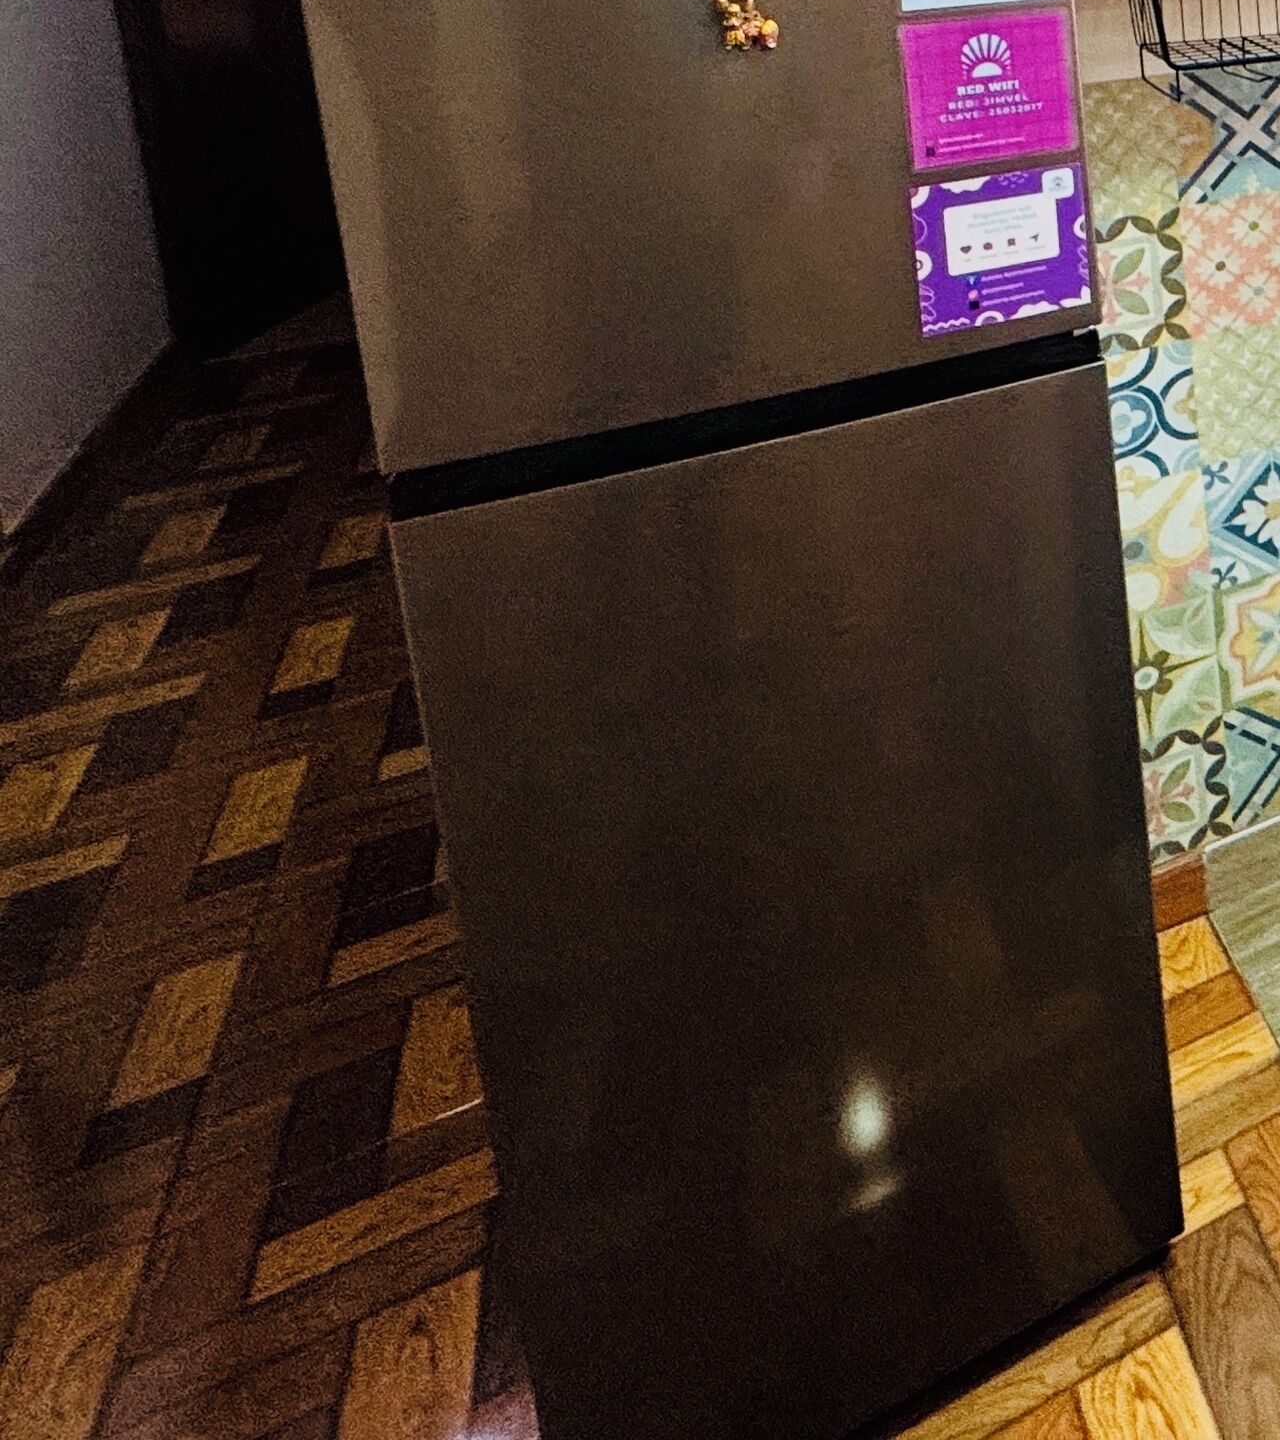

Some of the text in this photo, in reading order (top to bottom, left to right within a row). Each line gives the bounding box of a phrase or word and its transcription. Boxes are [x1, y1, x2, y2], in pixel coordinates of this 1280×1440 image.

[956, 79, 1020, 96] RED WIFI
[948, 98, 978, 111] RED:
[939, 110, 986, 124] CLAVE:
